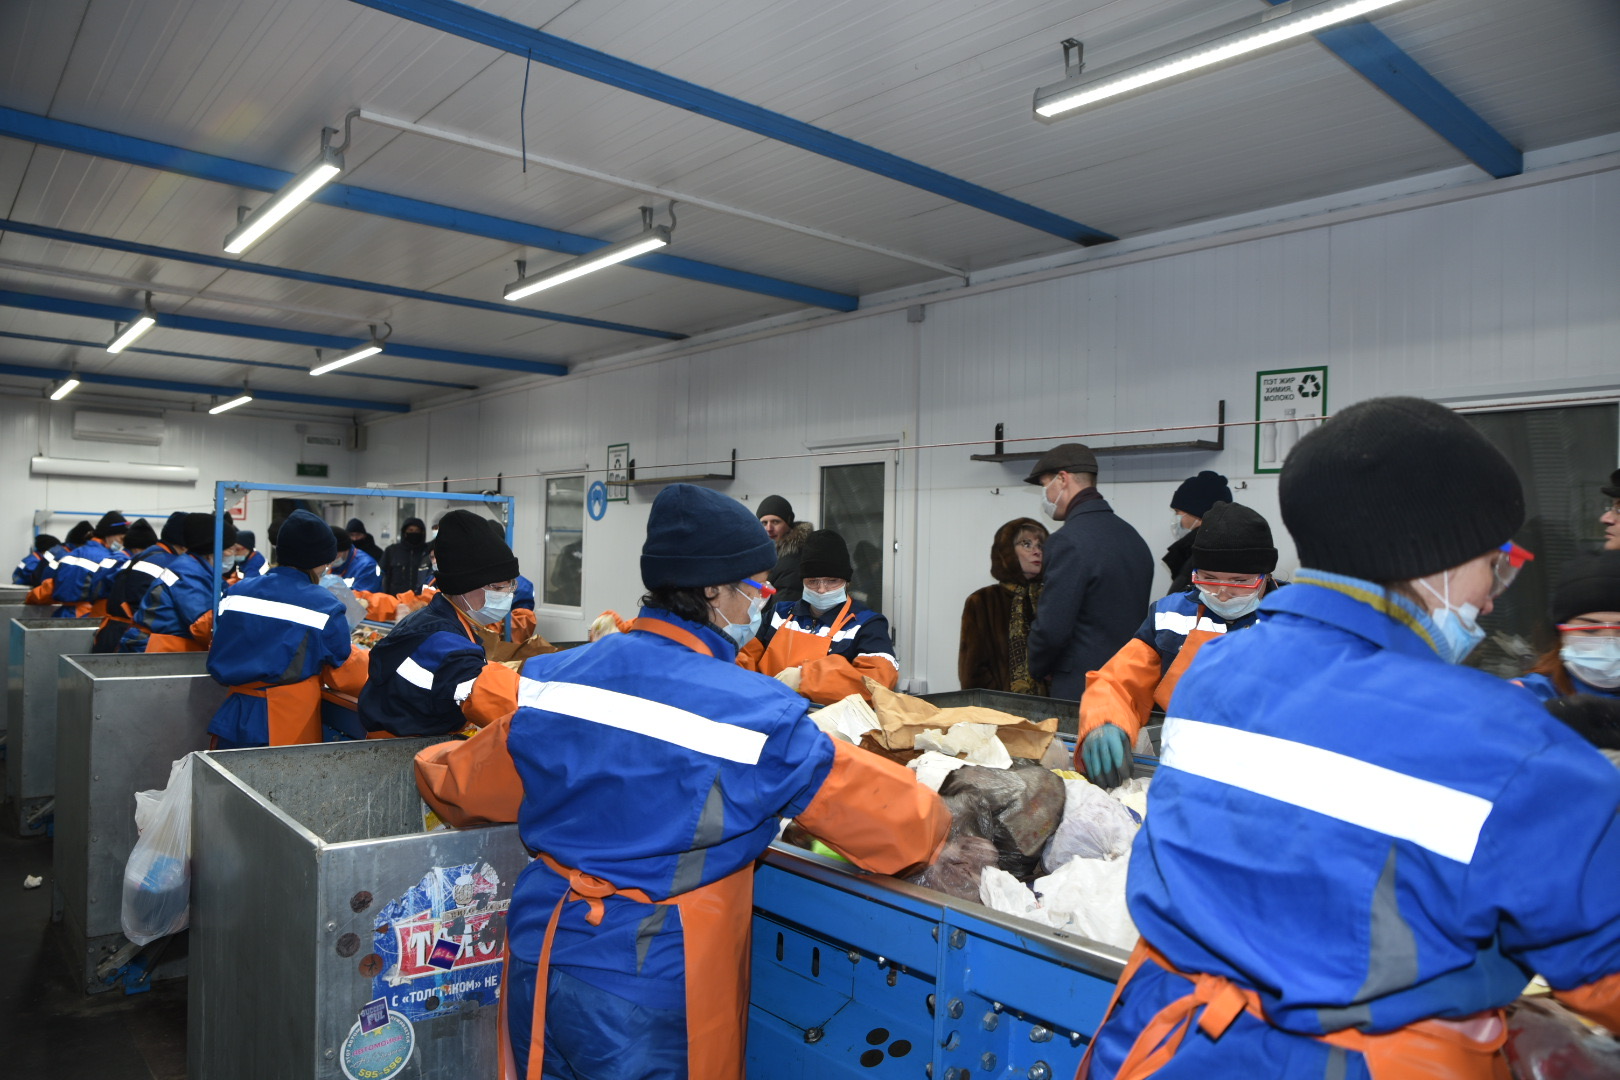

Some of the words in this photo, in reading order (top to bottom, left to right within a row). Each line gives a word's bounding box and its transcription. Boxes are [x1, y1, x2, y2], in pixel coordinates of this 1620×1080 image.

[1263, 377, 1278, 386] ПЭТ
[1279, 376, 1296, 385] ЖИР
[1263, 393, 1295, 402] МОЛОКО
[391, 995, 399, 1007] С
[484, 975, 498, 988] НЕ
[358, 1055, 403, 1079] 595-596
